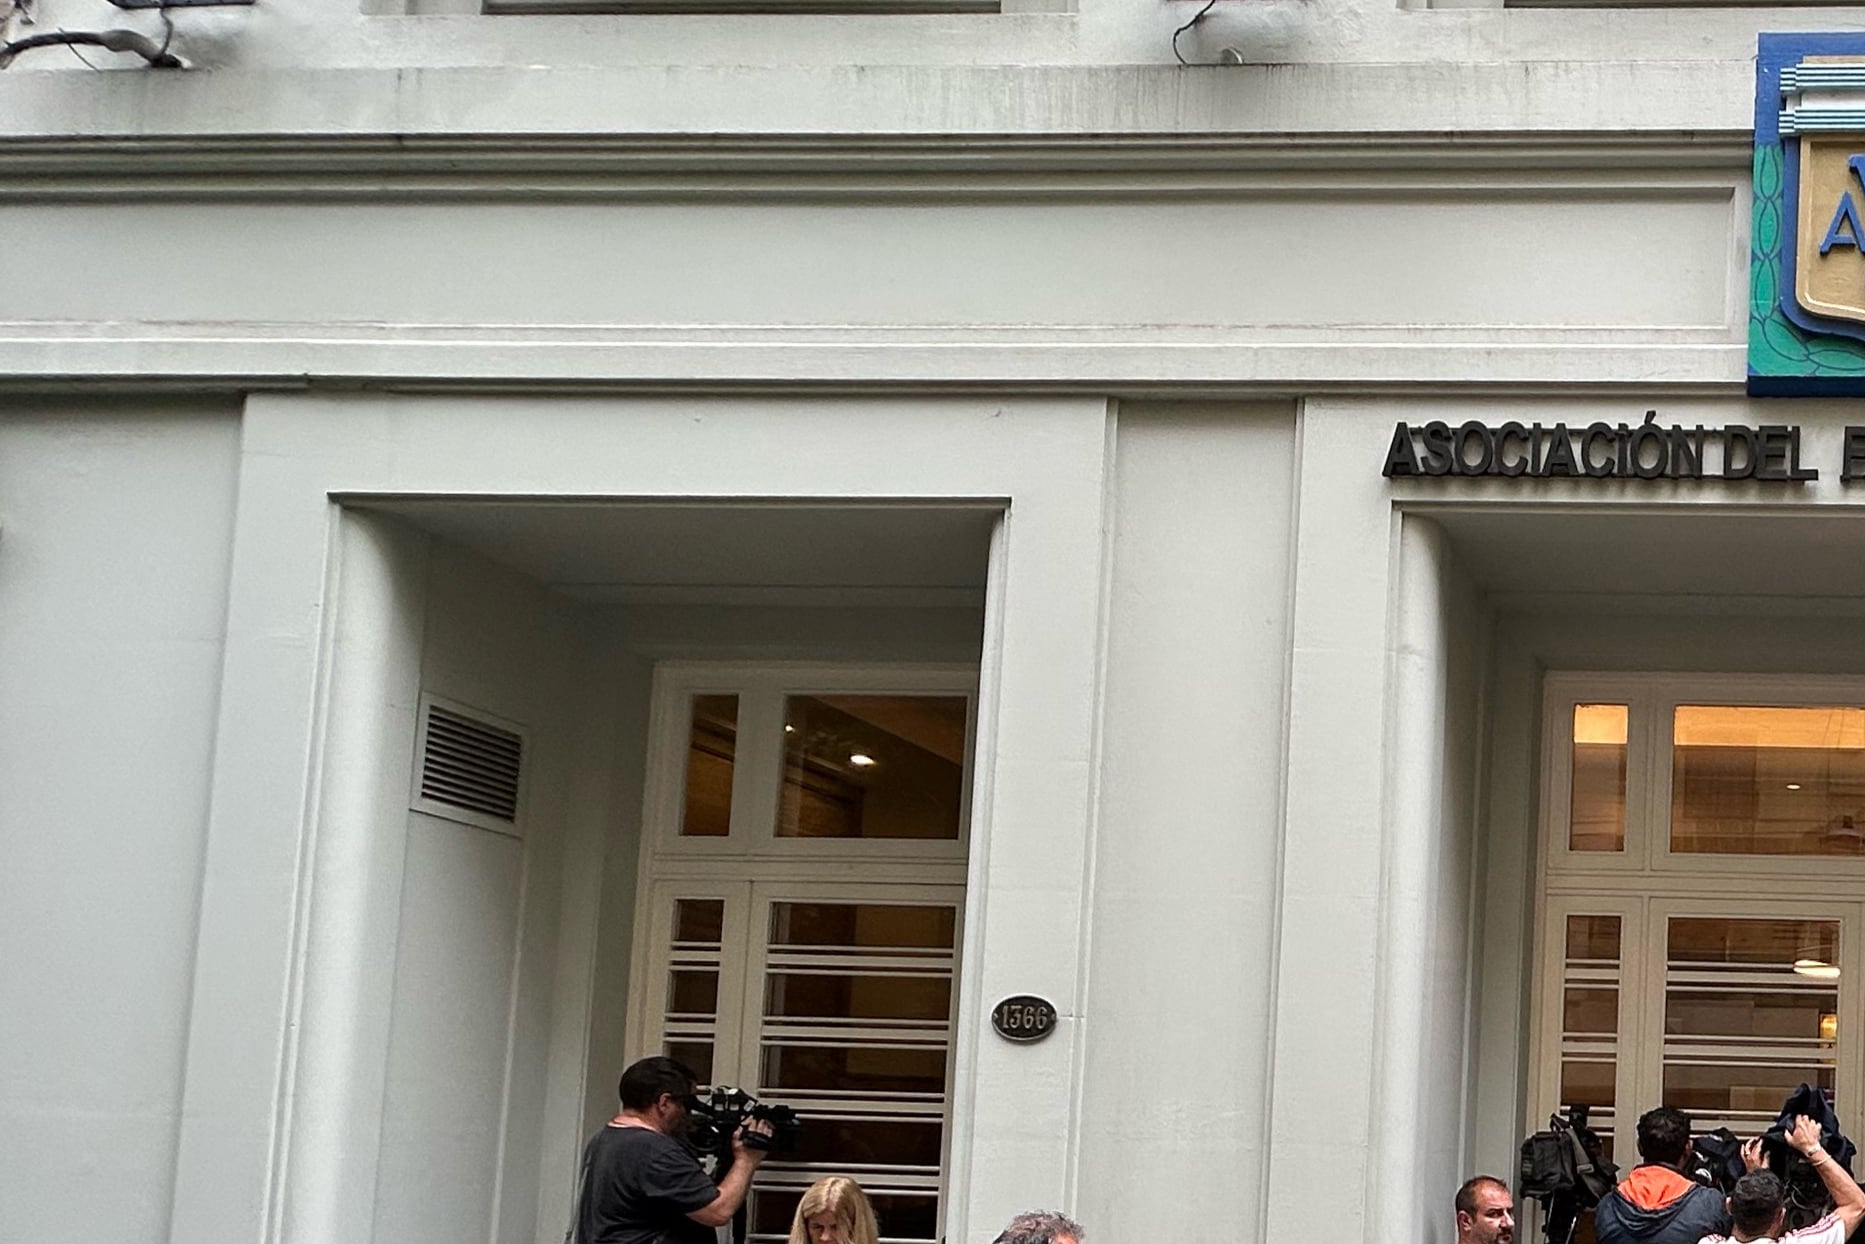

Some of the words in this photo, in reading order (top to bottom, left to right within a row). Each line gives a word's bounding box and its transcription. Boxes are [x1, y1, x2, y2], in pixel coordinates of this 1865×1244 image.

[1382, 410, 1704, 480] ASOCIACIÓN
[1723, 424, 1819, 481] DEL
[1002, 1005, 1048, 1030] 1366
